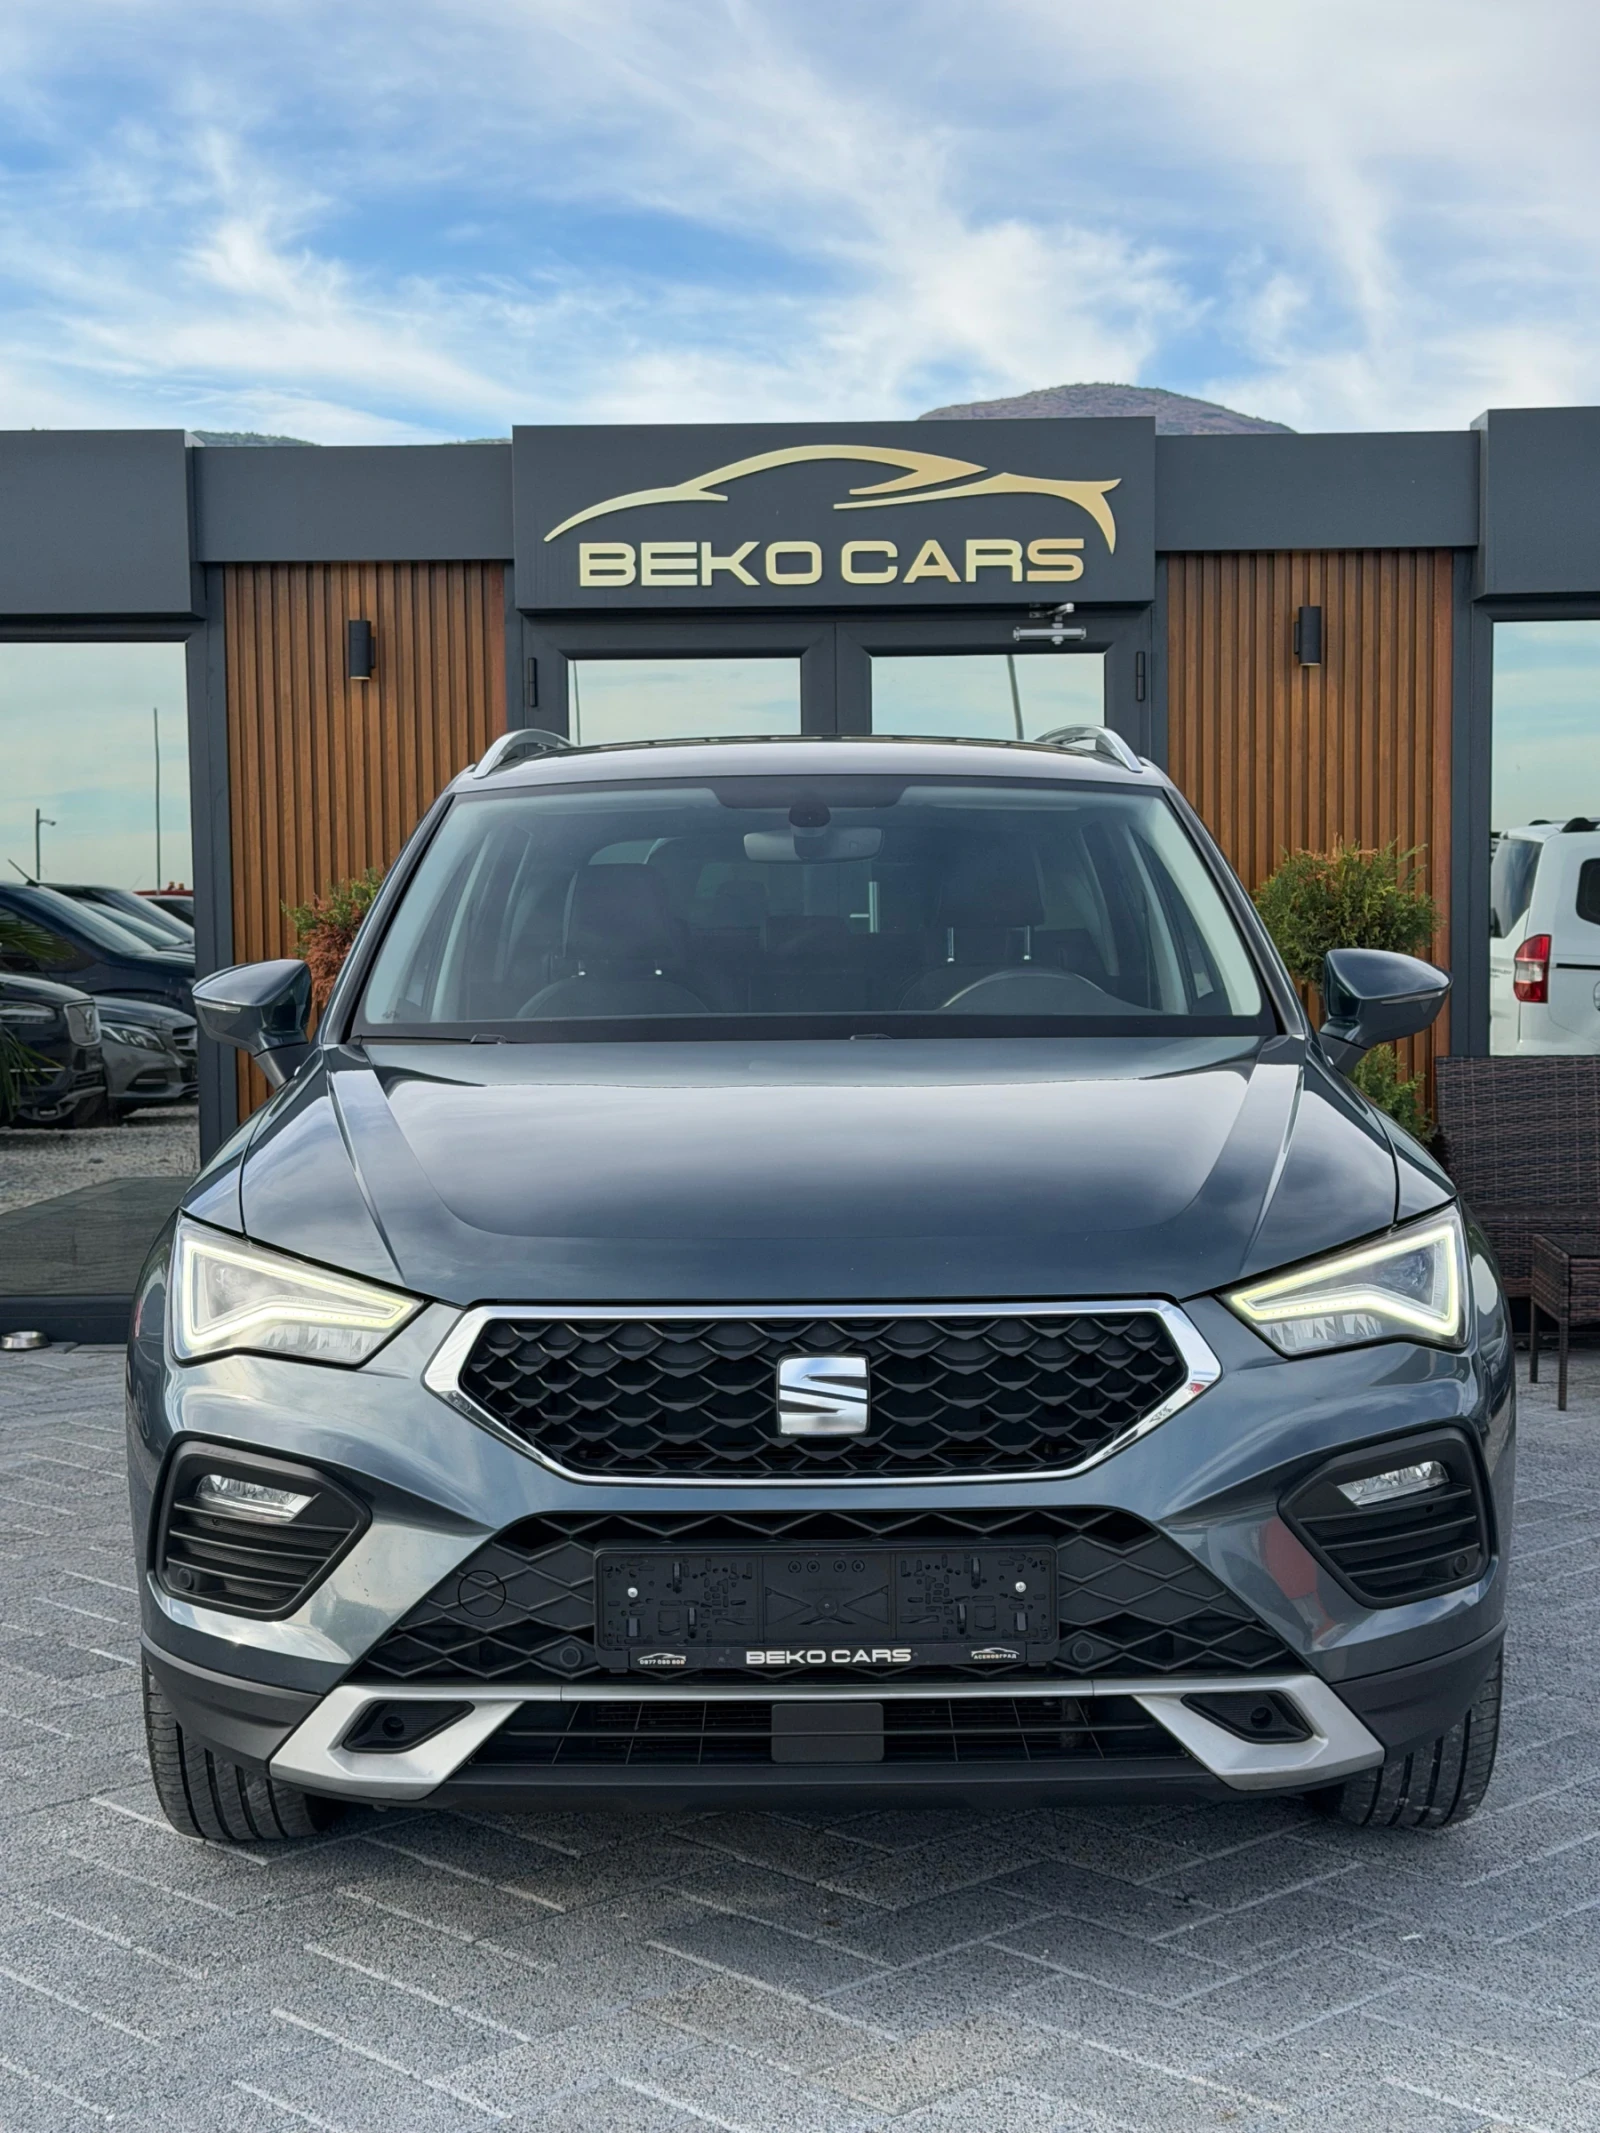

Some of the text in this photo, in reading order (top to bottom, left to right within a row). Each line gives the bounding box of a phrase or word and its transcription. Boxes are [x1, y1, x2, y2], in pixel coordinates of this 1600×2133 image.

[579, 538, 1085, 587] BEKO CARS
[745, 1648, 912, 1665] BEKO CARS
